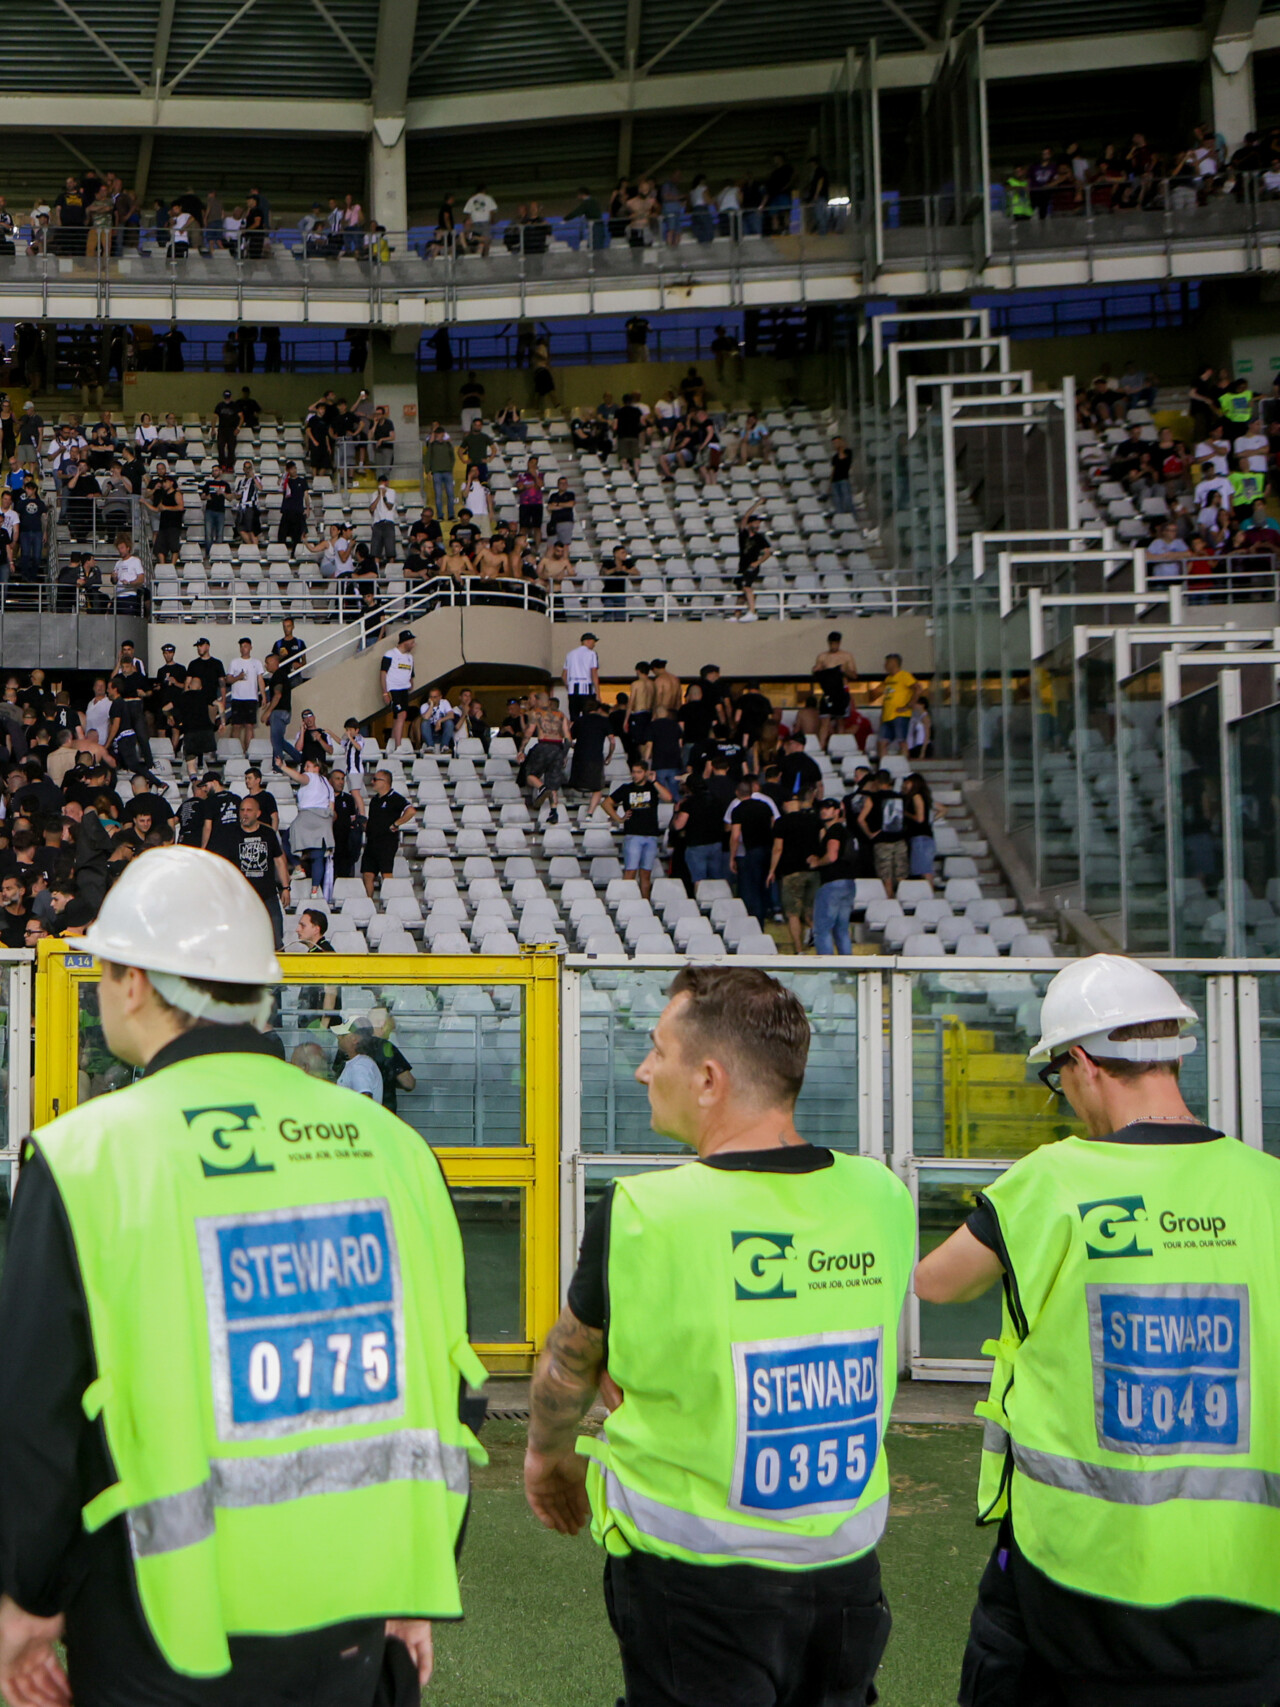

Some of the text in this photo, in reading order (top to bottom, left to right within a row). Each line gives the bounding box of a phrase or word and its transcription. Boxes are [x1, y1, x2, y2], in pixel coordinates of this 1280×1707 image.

[67, 956, 90, 966] A 14
[279, 1118, 360, 1147] Group
[1159, 1210, 1226, 1238] Group
[1163, 1239, 1237, 1249] YOUR JOB, OUR WORK
[229, 1233, 384, 1302] STEWARD
[808, 1249, 875, 1276] Group
[808, 1276, 882, 1290] YOUR JOB, OUR WORK
[1110, 1311, 1233, 1353] STEWARD
[249, 1331, 389, 1404] 0175
[752, 1356, 875, 1417] STEWARD
[755, 1433, 867, 1495] 0355
